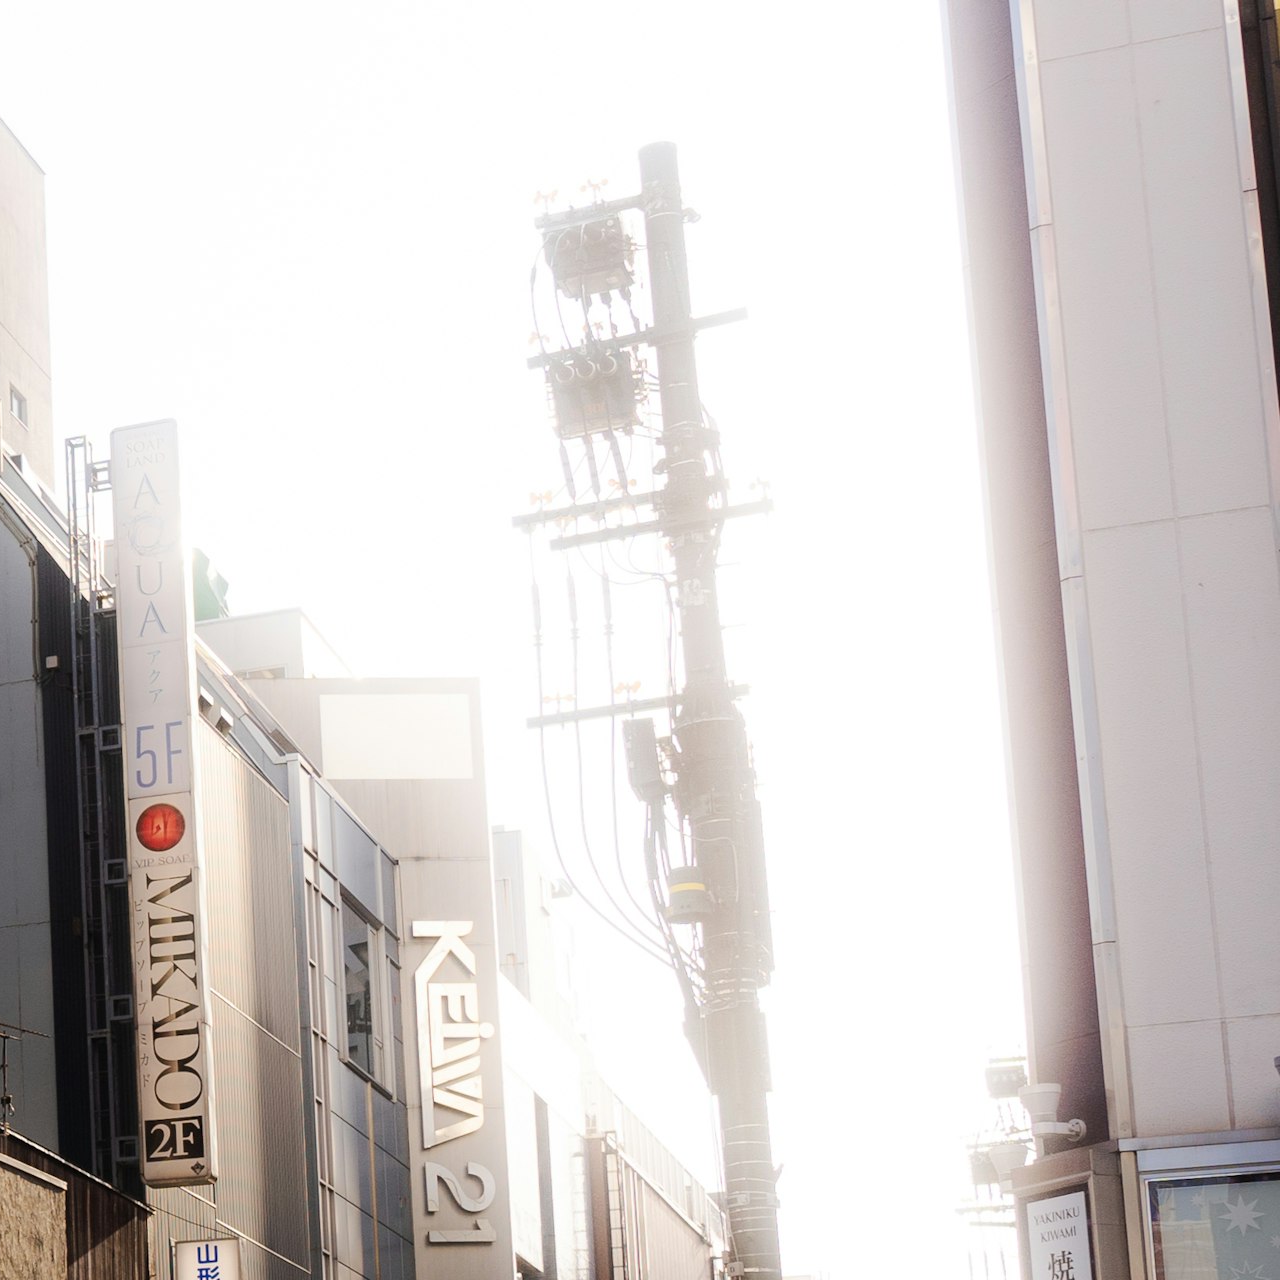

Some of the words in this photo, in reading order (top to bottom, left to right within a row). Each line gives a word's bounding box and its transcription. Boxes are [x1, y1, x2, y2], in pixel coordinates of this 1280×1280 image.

[125, 438, 164, 455] SOAP
[126, 453, 166, 468] LAND
[135, 721, 184, 791] 5F
[135, 855, 157, 869] VIP
[159, 851, 191, 867] SOAP
[146, 868, 204, 1113] MIKADO
[138, 1031, 153, 1089] ミカド
[150, 1120, 201, 1161] 2F
[425, 1161, 496, 1244] 21
[1033, 1206, 1080, 1227] YAKINIKU
[1040, 1225, 1077, 1244] KIWAMI
